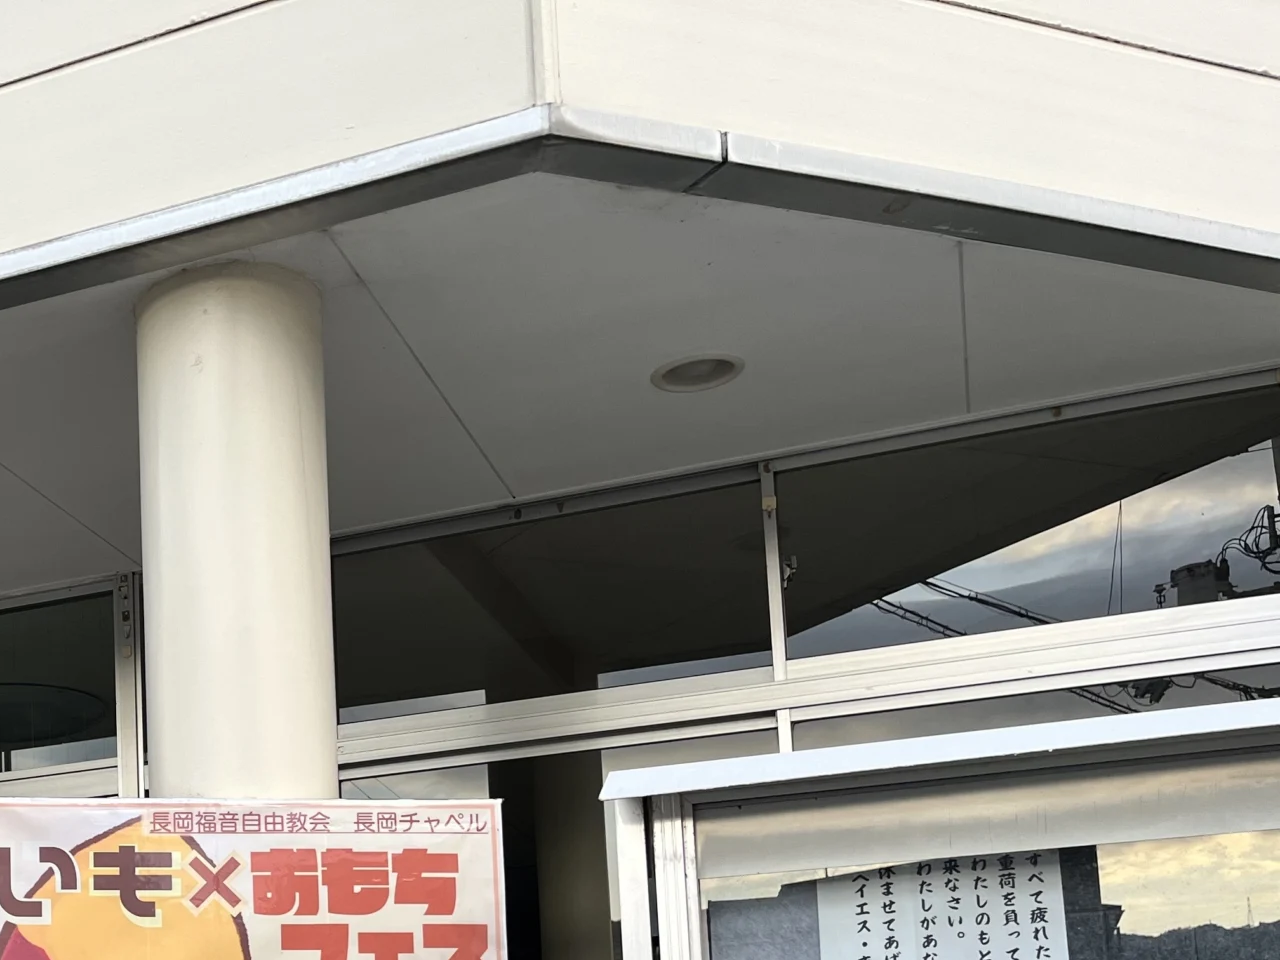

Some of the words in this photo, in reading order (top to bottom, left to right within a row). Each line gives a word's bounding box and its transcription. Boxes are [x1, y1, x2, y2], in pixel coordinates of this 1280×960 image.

[150, 811, 331, 833] 長岡福音自由教会
[353, 811, 487, 833] 長岡チャペル
[942, 858, 966, 939] 来なさい。
